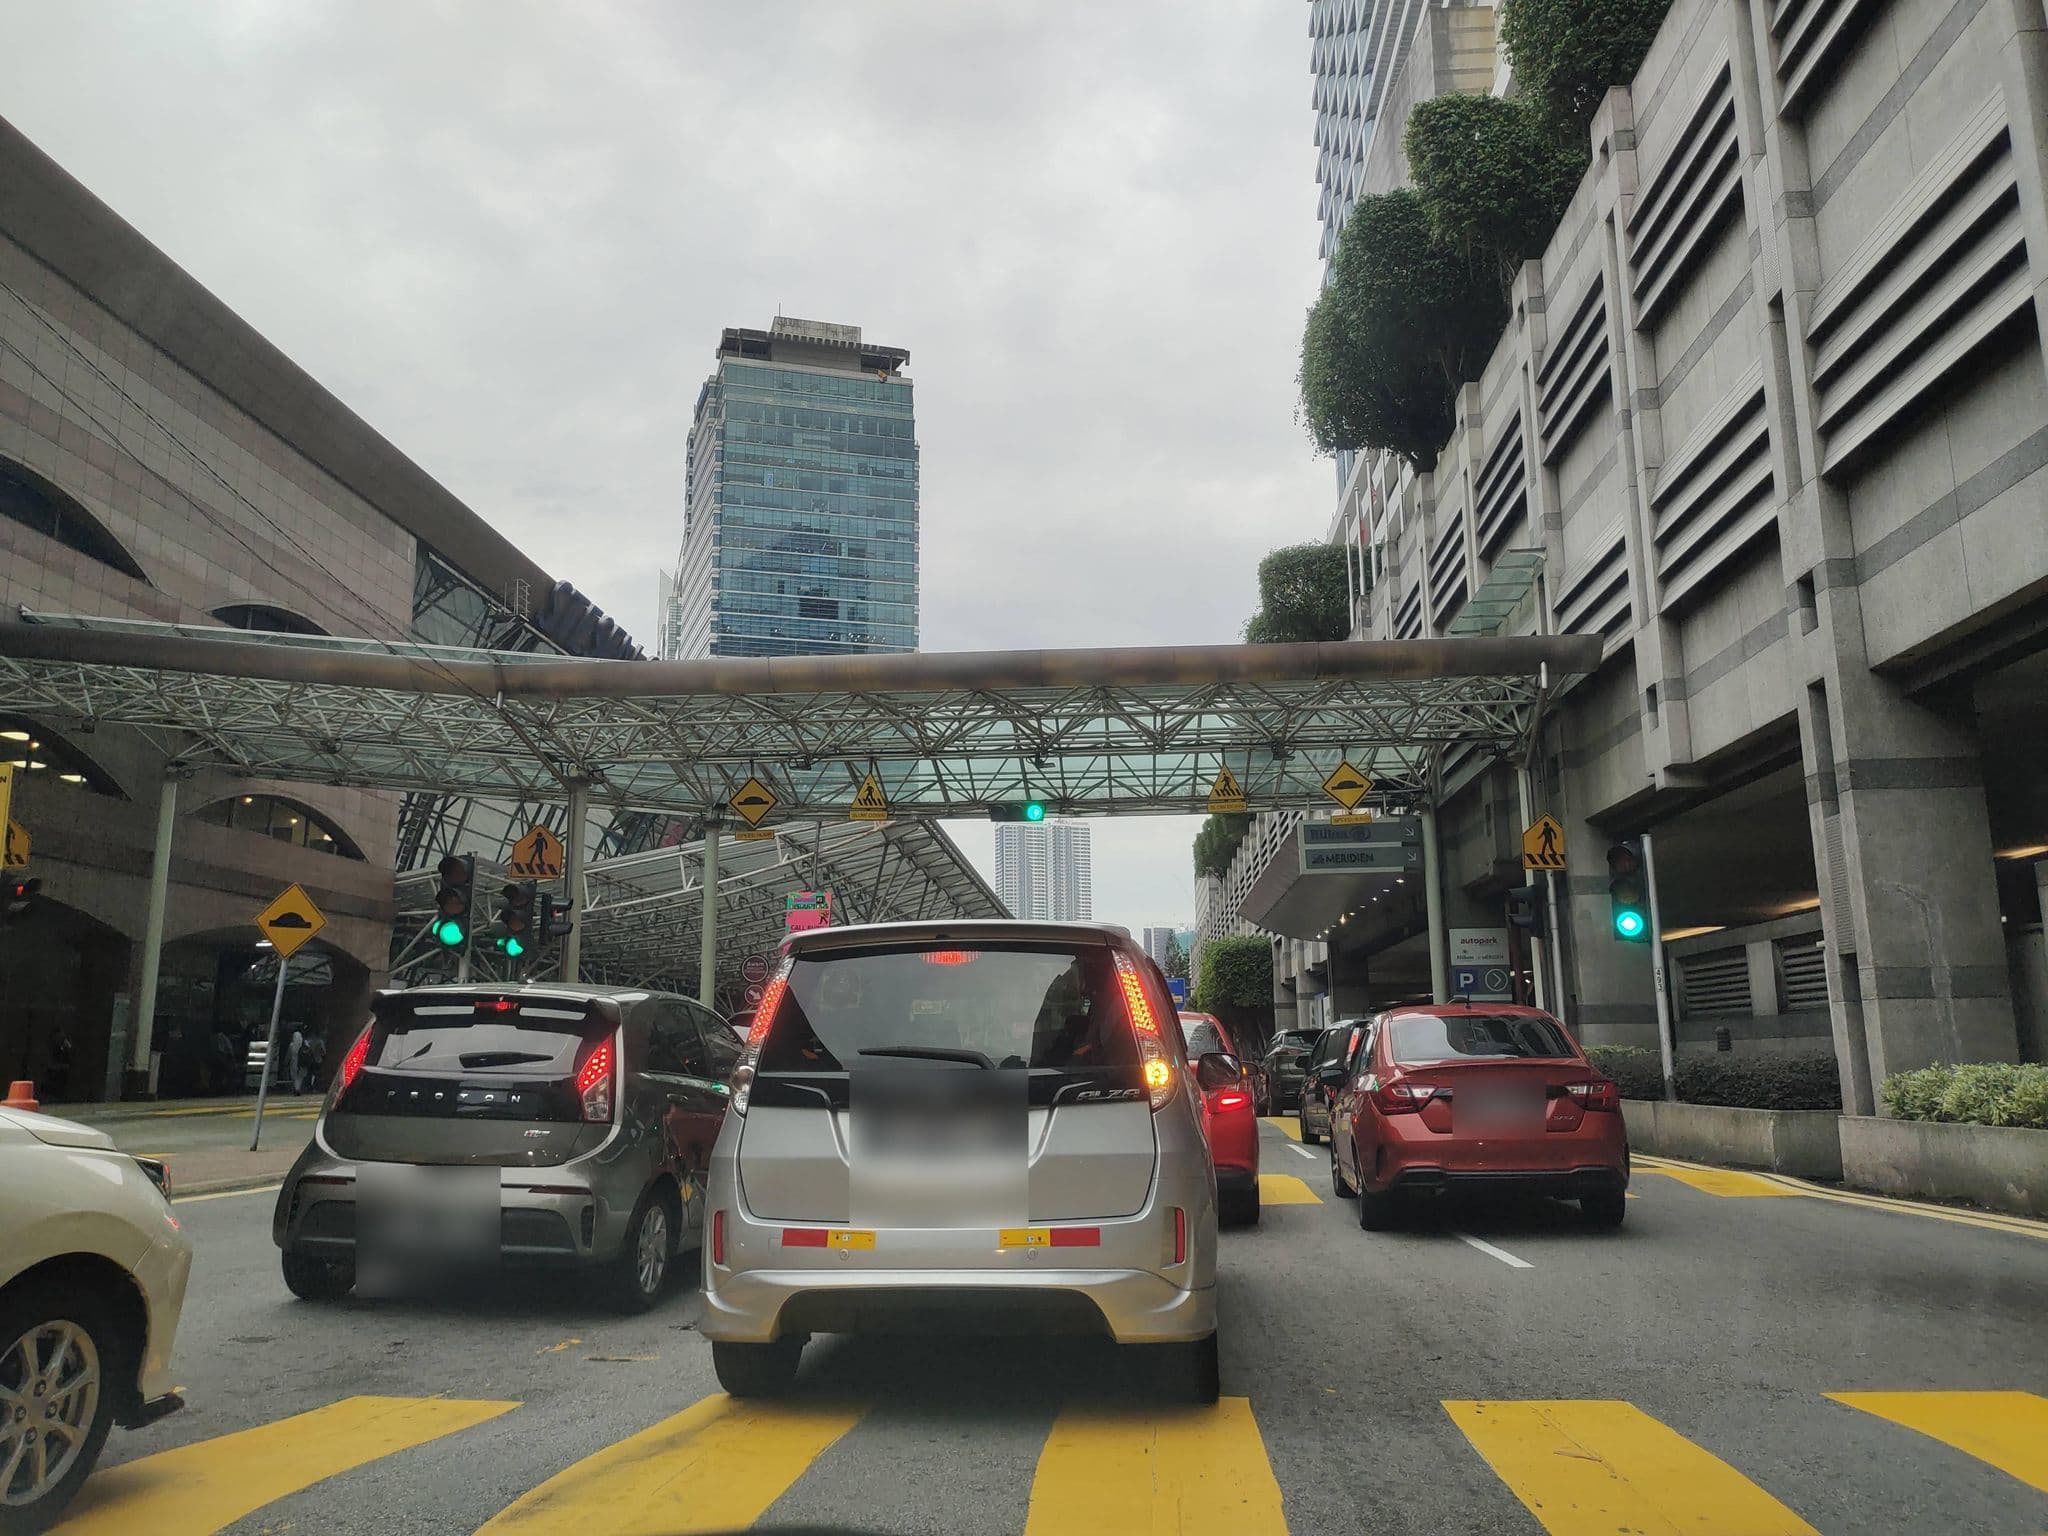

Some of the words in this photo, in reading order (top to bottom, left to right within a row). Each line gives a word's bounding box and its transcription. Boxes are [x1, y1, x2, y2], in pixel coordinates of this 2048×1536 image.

[1460, 936, 1498, 945] autopark
[1459, 973, 1474, 988] P
[387, 1090, 521, 1104] PROTON
